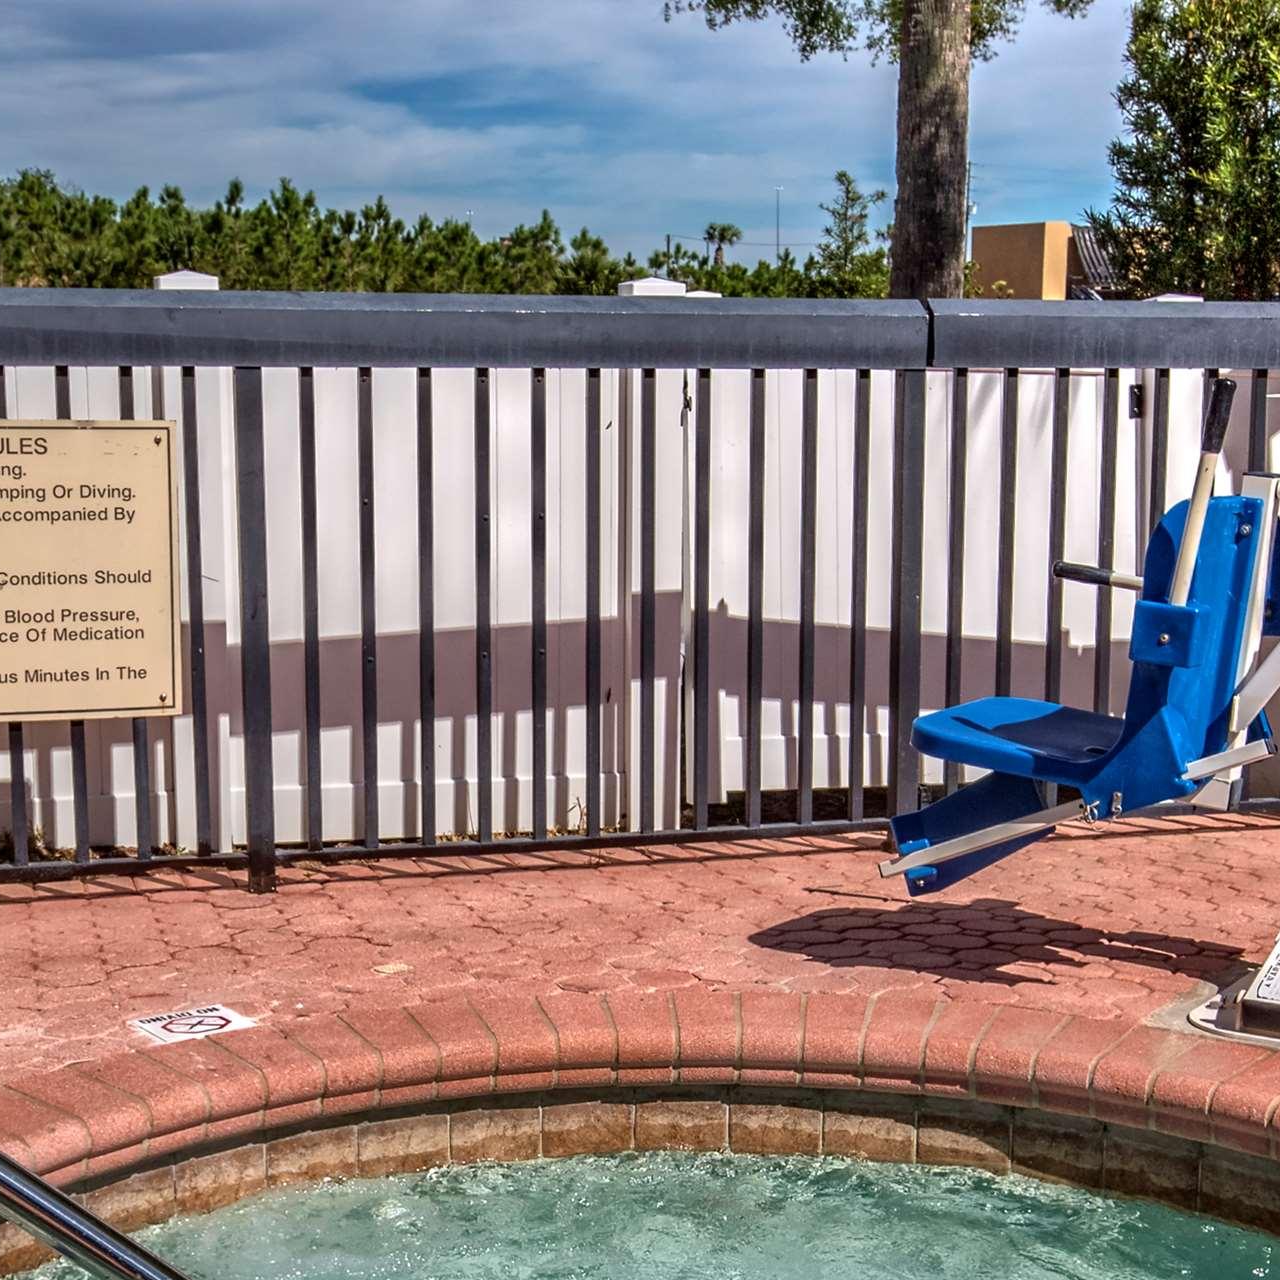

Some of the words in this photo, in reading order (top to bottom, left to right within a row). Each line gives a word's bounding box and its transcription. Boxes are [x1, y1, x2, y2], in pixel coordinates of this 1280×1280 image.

[51, 483, 73, 499] Or
[79, 483, 136, 502] Diving.
[113, 506, 135, 524] By
[94, 569, 151, 584] Should
[4, 608, 54, 623] Blood
[60, 608, 139, 622] Pressure,
[25, 627, 46, 642] Of
[52, 625, 144, 641] Medication
[24, 668, 90, 683] Minutes
[95, 666, 110, 680] In
[115, 665, 147, 680] The
